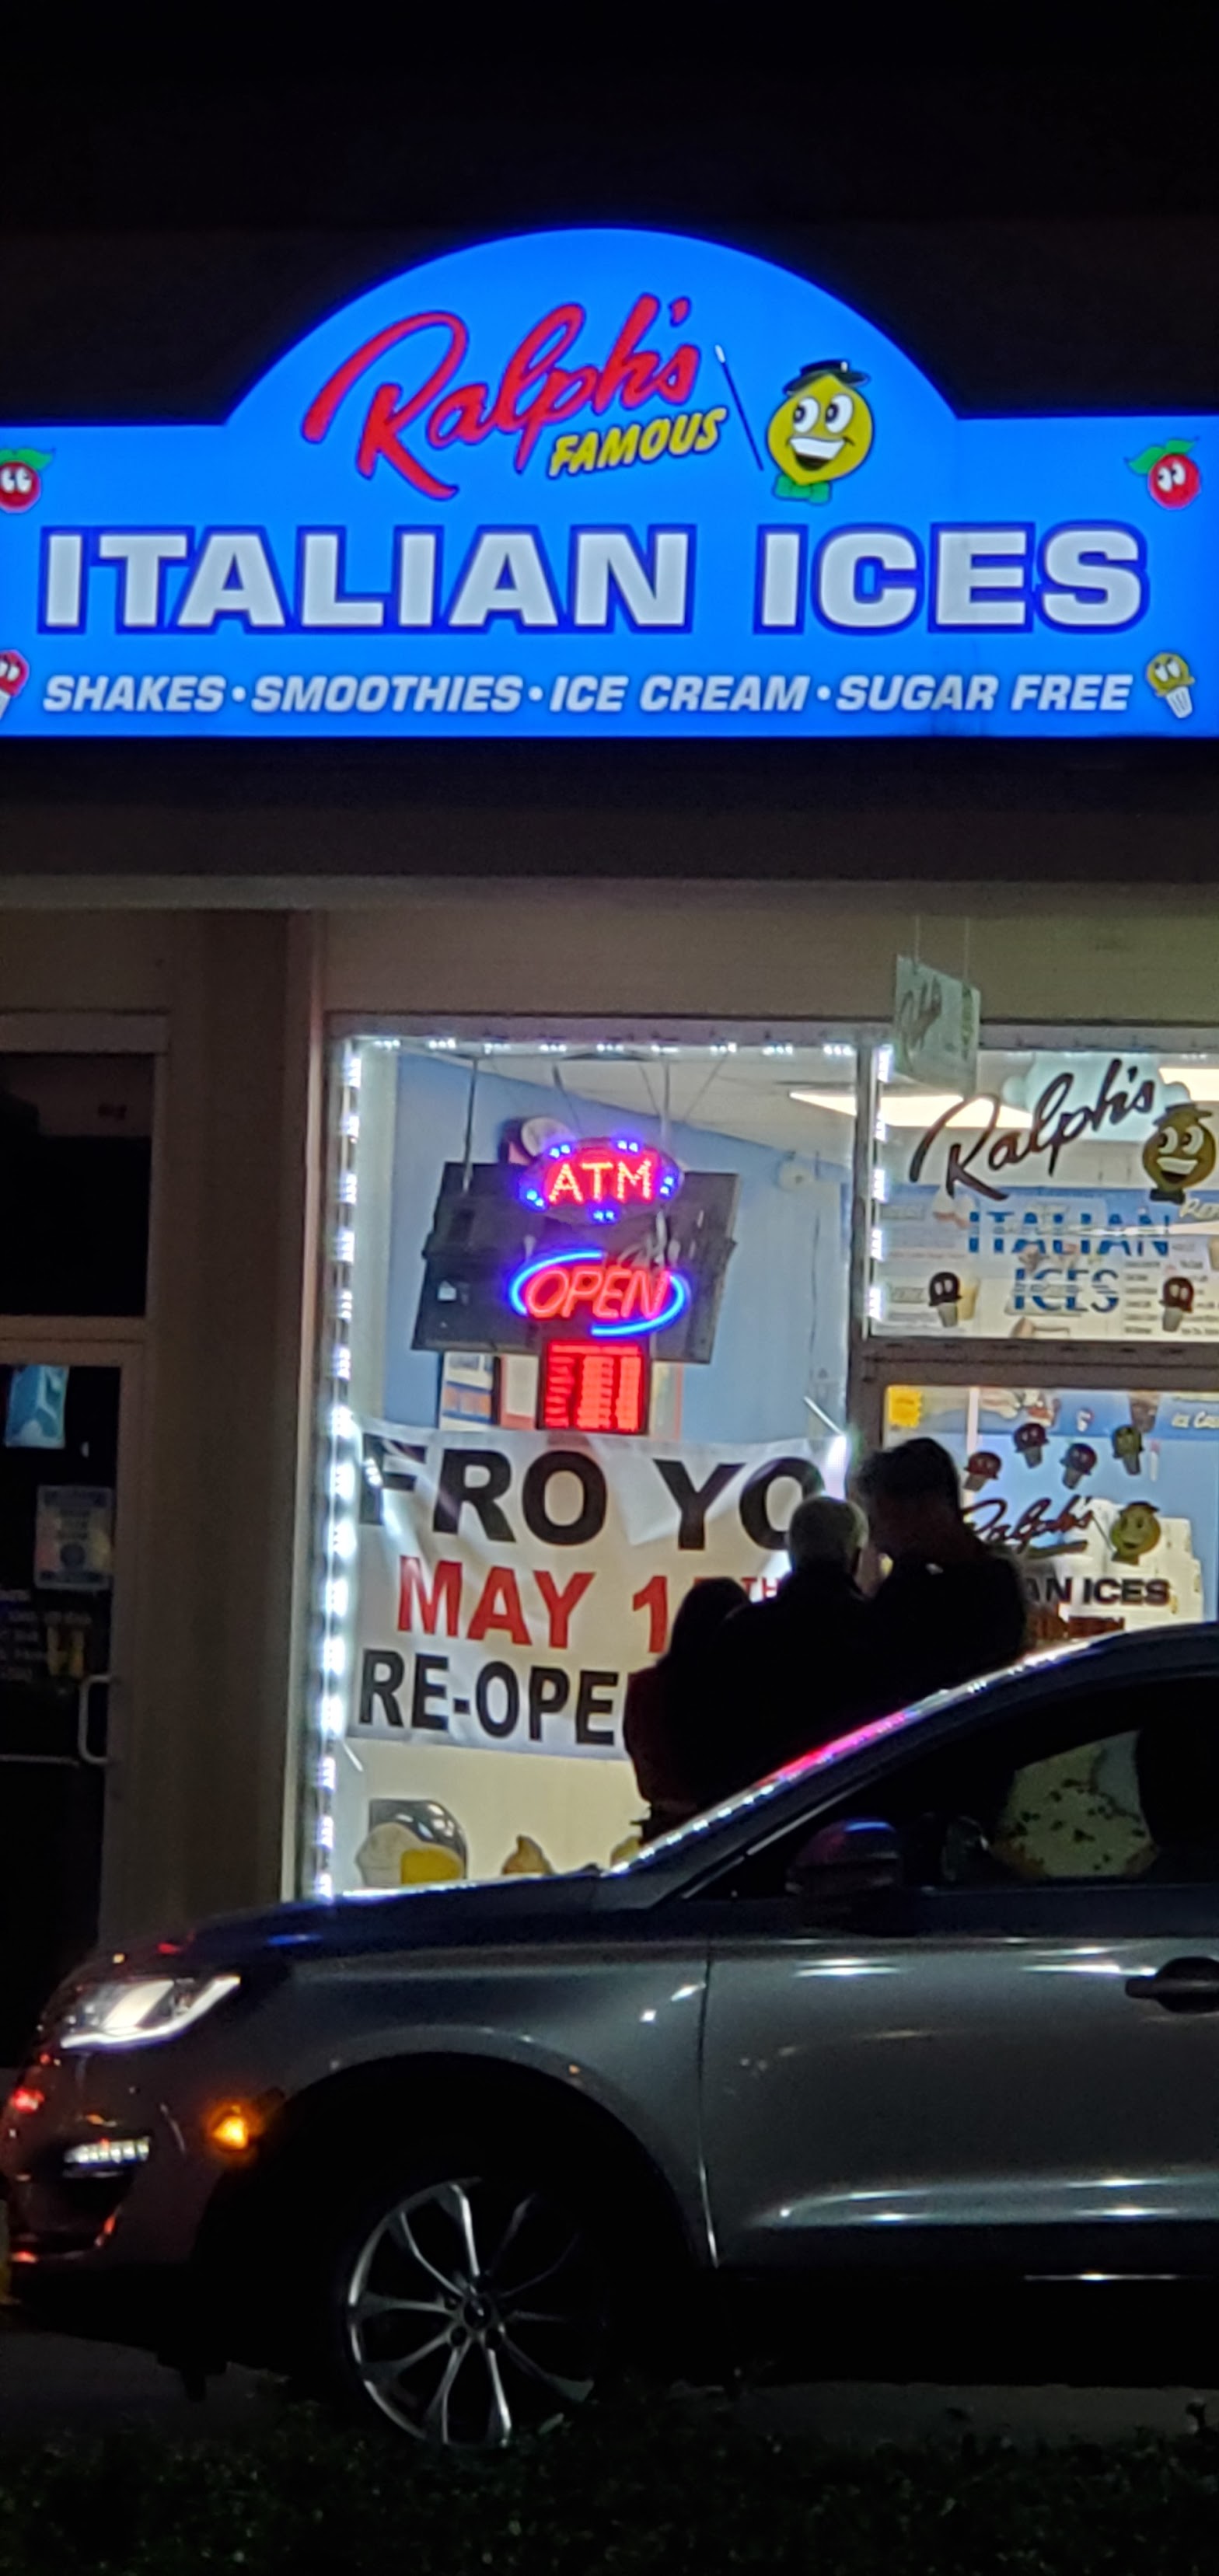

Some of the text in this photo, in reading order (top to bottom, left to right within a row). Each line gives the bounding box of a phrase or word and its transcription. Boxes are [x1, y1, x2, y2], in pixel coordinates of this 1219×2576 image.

[302, 294, 700, 500] Ralph's
[549, 407, 727, 477] FAMOUS
[42, 526, 1144, 632] ITALIAN ICES
[44, 674, 1133, 712] SHAKES SMOOTHIES ICE CREAM SUGAR FREE
[909, 1059, 1155, 1202] Ralph's
[547, 1160, 652, 1202] ATM
[968, 1211, 1171, 1257] ITALIAN
[526, 1266, 672, 1320] OPEN
[1014, 1267, 1120, 1314] ICES
[358, 1433, 828, 1552] FRO YO
[397, 1555, 595, 1649] MAY
[1083, 1578, 1171, 1607] ICES
[358, 1649, 620, 1746] RE-OPE
